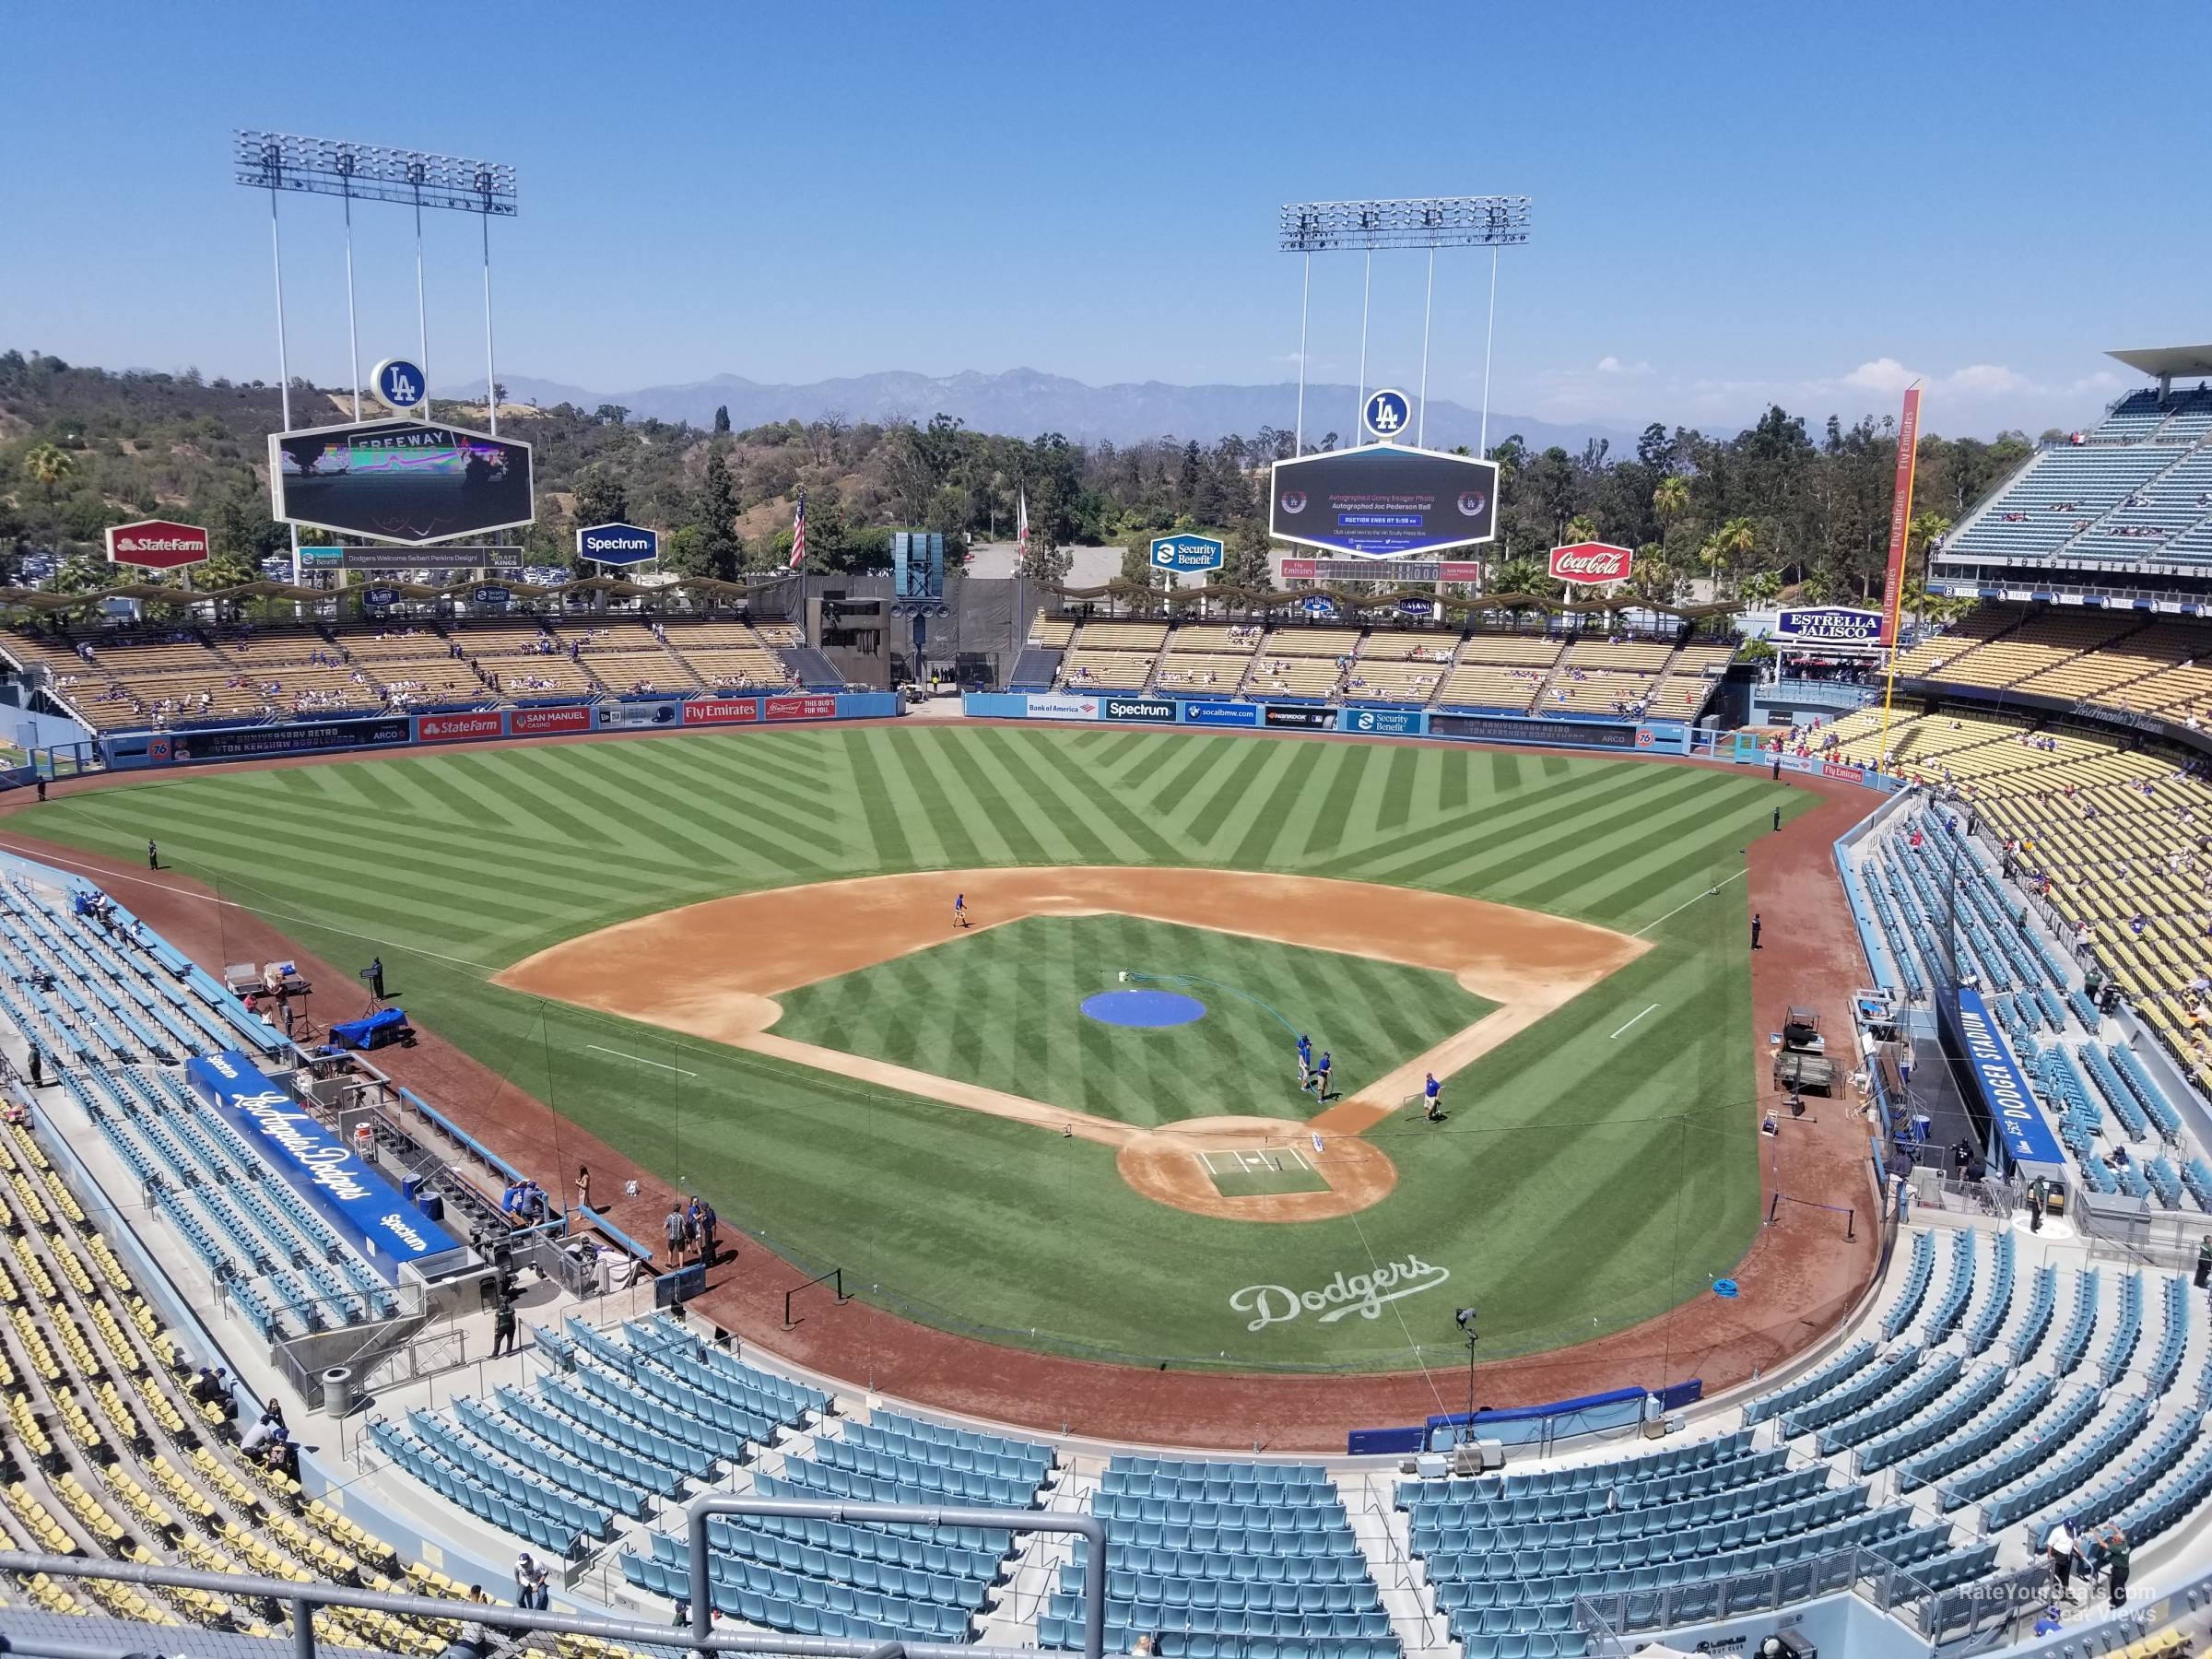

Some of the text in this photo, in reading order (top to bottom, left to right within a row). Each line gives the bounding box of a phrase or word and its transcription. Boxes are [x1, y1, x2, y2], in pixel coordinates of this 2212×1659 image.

[390, 367, 416, 401] LA
[1375, 397, 1398, 429] LA
[359, 431, 443, 452] FREEWAY
[1900, 411, 1913, 469] Fly Emirates
[1891, 490, 1905, 547] Fly Emirates
[587, 537, 648, 552] Spectrum
[1178, 544, 1217, 556] Security
[348, 555, 376, 563] Dodgers
[1178, 555, 1212, 565] Benefit
[1283, 567, 1313, 575] Emirates
[2006, 558, 2082, 571] DODGER
[2097, 561, 2178, 576] STADIUM
[1304, 595, 1332, 607] JIM BEAM
[1883, 568, 1897, 624] Fly Emirates
[1401, 601, 1430, 610] DASANI
[1791, 614, 1877, 629] ESTRELLA
[1797, 626, 1868, 639] JALISCO
[686, 703, 755, 720] Fly Emirates
[1030, 704, 1046, 712] Bank
[1053, 705, 1078, 713] America
[1111, 703, 1169, 717] Spectrum
[1203, 708, 1253, 718] socalbmw.com
[527, 712, 585, 723] SAN MANUEL
[1377, 713, 1408, 724] Security
[308, 728, 338, 738] RETRO
[1377, 723, 1404, 732] Benefit
[1543, 724, 1570, 734] RETRO
[373, 731, 398, 740] ARCO
[244, 740, 291, 751] KERSHAW
[1825, 765, 1861, 782] Fly Emirates
[1961, 1012, 2002, 1061] STADIUM
[206, 1054, 239, 1078] Spectrum
[1982, 1065, 2032, 1120] DODGER
[258, 1112, 320, 1153] Angeles
[299, 1147, 371, 1200] Dodgers
[381, 1213, 427, 1252] Spectrum
[1230, 1254, 1450, 1332] Dodgers
[269, 1451, 285, 1464] 24
